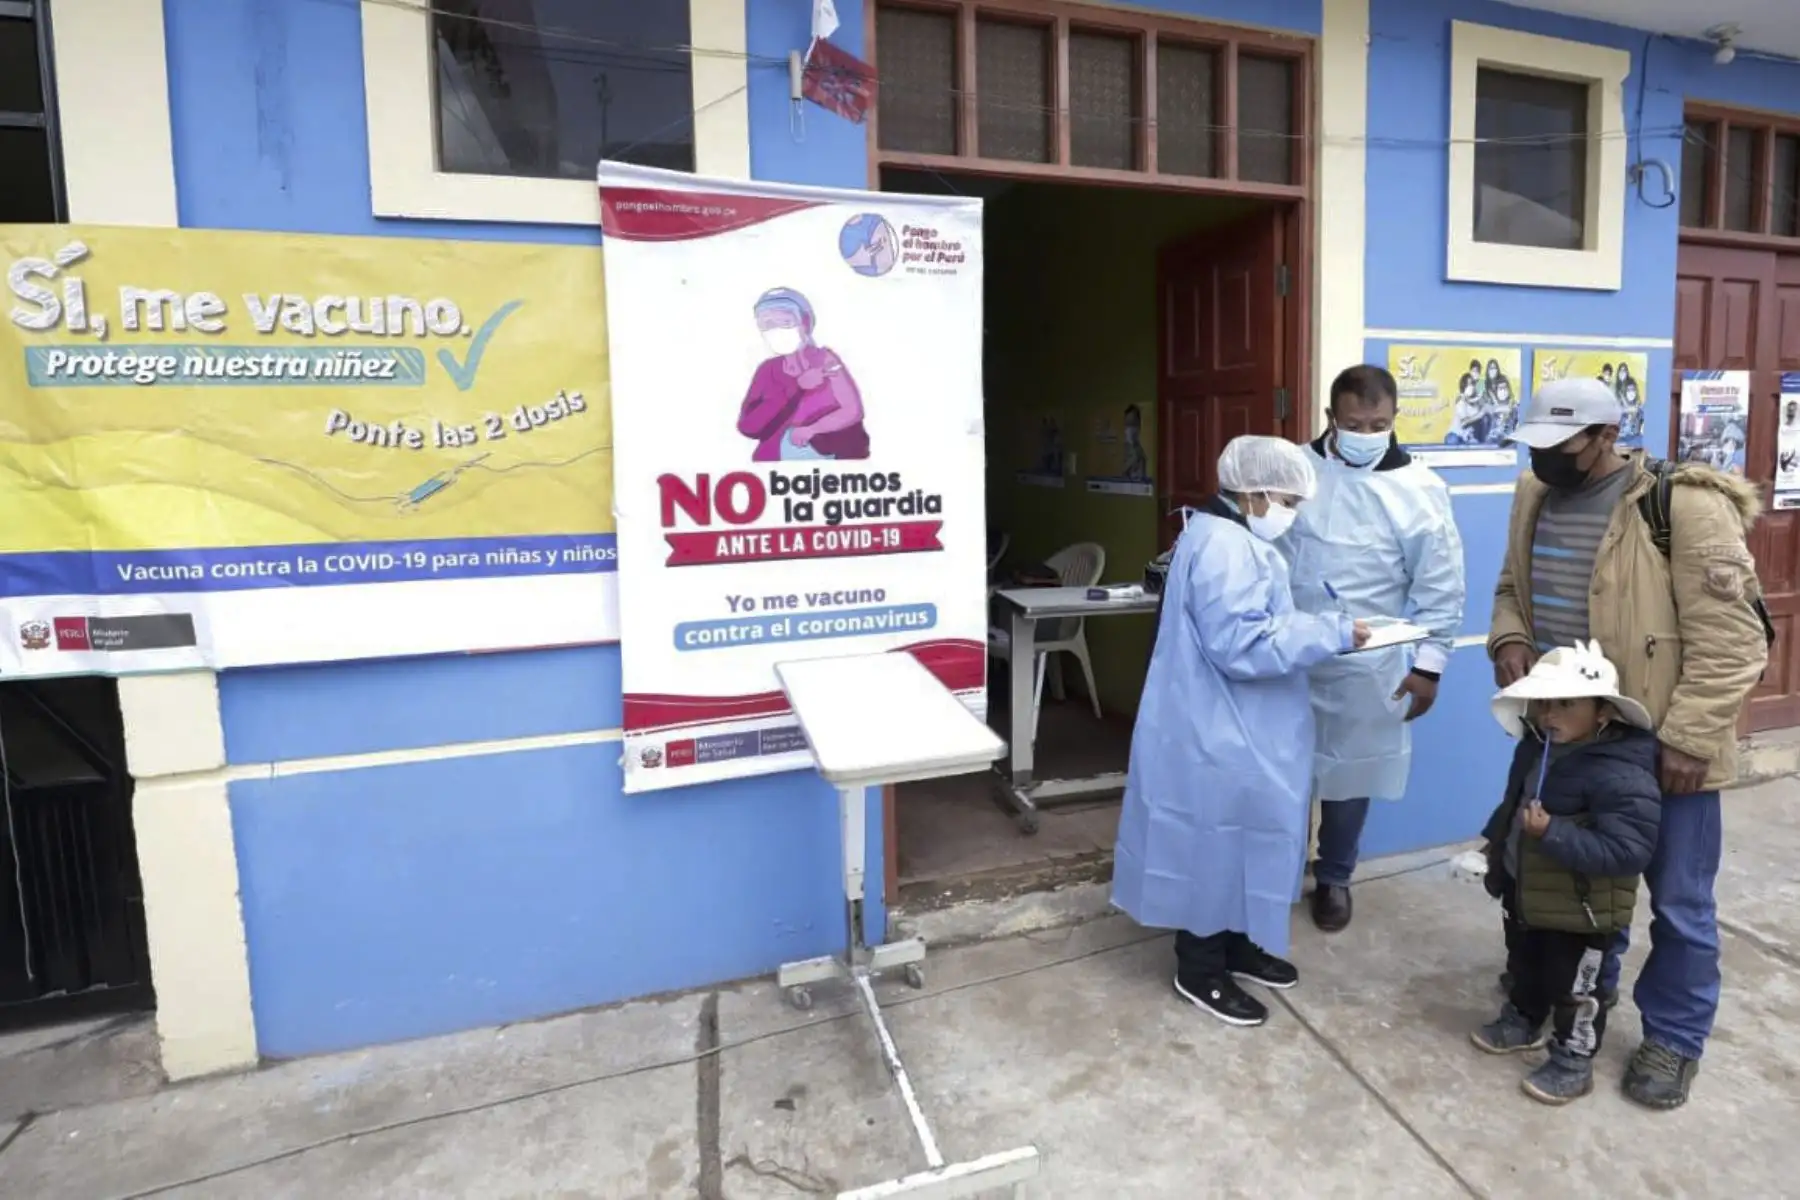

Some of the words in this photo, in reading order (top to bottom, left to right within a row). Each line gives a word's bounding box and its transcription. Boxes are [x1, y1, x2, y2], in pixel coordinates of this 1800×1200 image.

[902, 239, 913, 249] el
[902, 252, 922, 264] por
[923, 251, 935, 262] el
[8, 240, 108, 340] Sí,
[119, 286, 227, 333] me
[242, 293, 472, 336] vacuno.
[47, 350, 176, 384] Protege
[182, 353, 307, 378] nuestra
[313, 350, 397, 378] niñez
[325, 408, 423, 449] Ponte
[434, 419, 479, 448] las
[484, 413, 506, 440] 2
[510, 389, 588, 432] dosis
[656, 471, 767, 528] NO
[770, 468, 901, 500] bajemos
[784, 498, 813, 523] la
[822, 489, 942, 525] guardia
[715, 533, 772, 557] ANTE
[779, 530, 806, 553] LA
[812, 527, 900, 551] COVID-19
[117, 563, 204, 581] Vacuna
[211, 559, 291, 578] contra
[297, 556, 318, 573] la
[324, 552, 427, 572] COVID-19
[432, 552, 480, 572] para
[485, 547, 542, 566] niñas
[546, 549, 558, 566] y
[563, 544, 617, 562] niños
[725, 593, 756, 613] Yo
[763, 591, 799, 610] me
[804, 587, 886, 608] vacuno
[685, 623, 764, 645] contra
[770, 620, 791, 638] el
[797, 609, 929, 636] coronavirus
